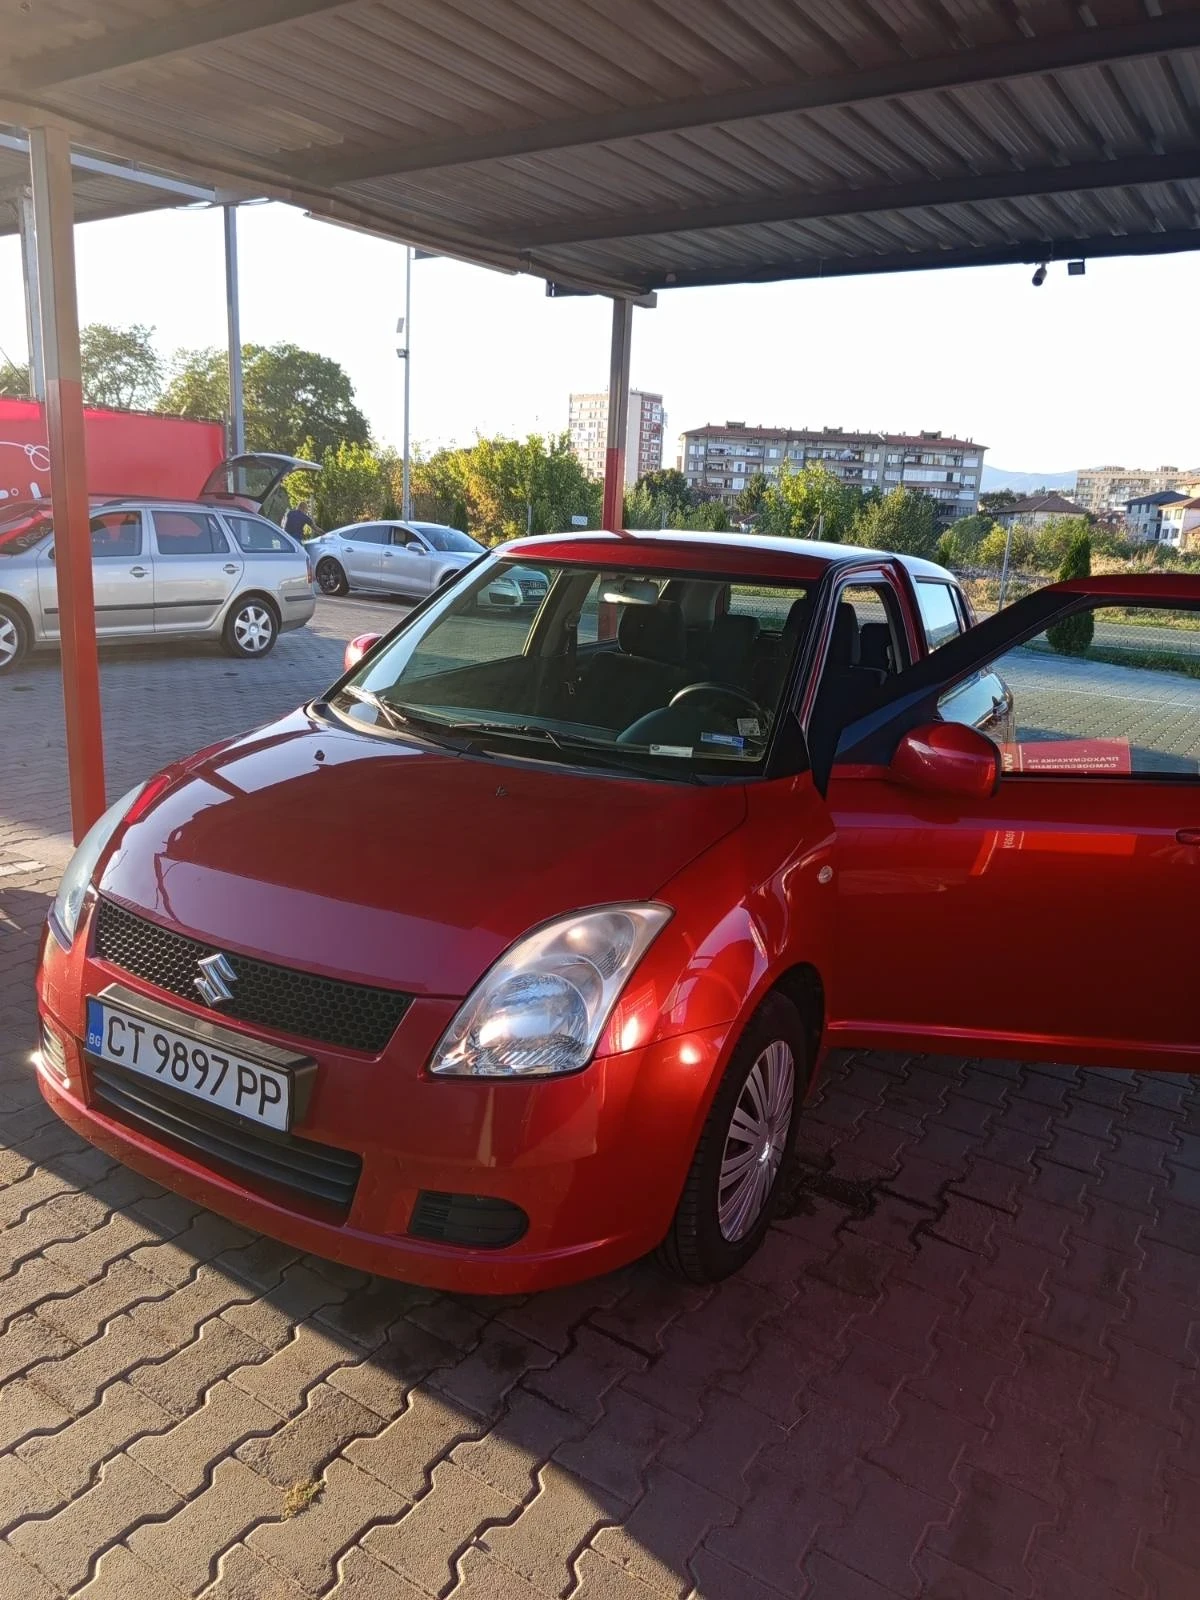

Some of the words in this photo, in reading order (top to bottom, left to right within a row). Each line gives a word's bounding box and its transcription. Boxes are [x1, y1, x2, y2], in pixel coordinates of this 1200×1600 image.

[88, 1032, 101, 1047] BG
[107, 1015, 145, 1064] CT
[153, 1033, 229, 1097] 9897
[235, 1065, 281, 1116] PP
